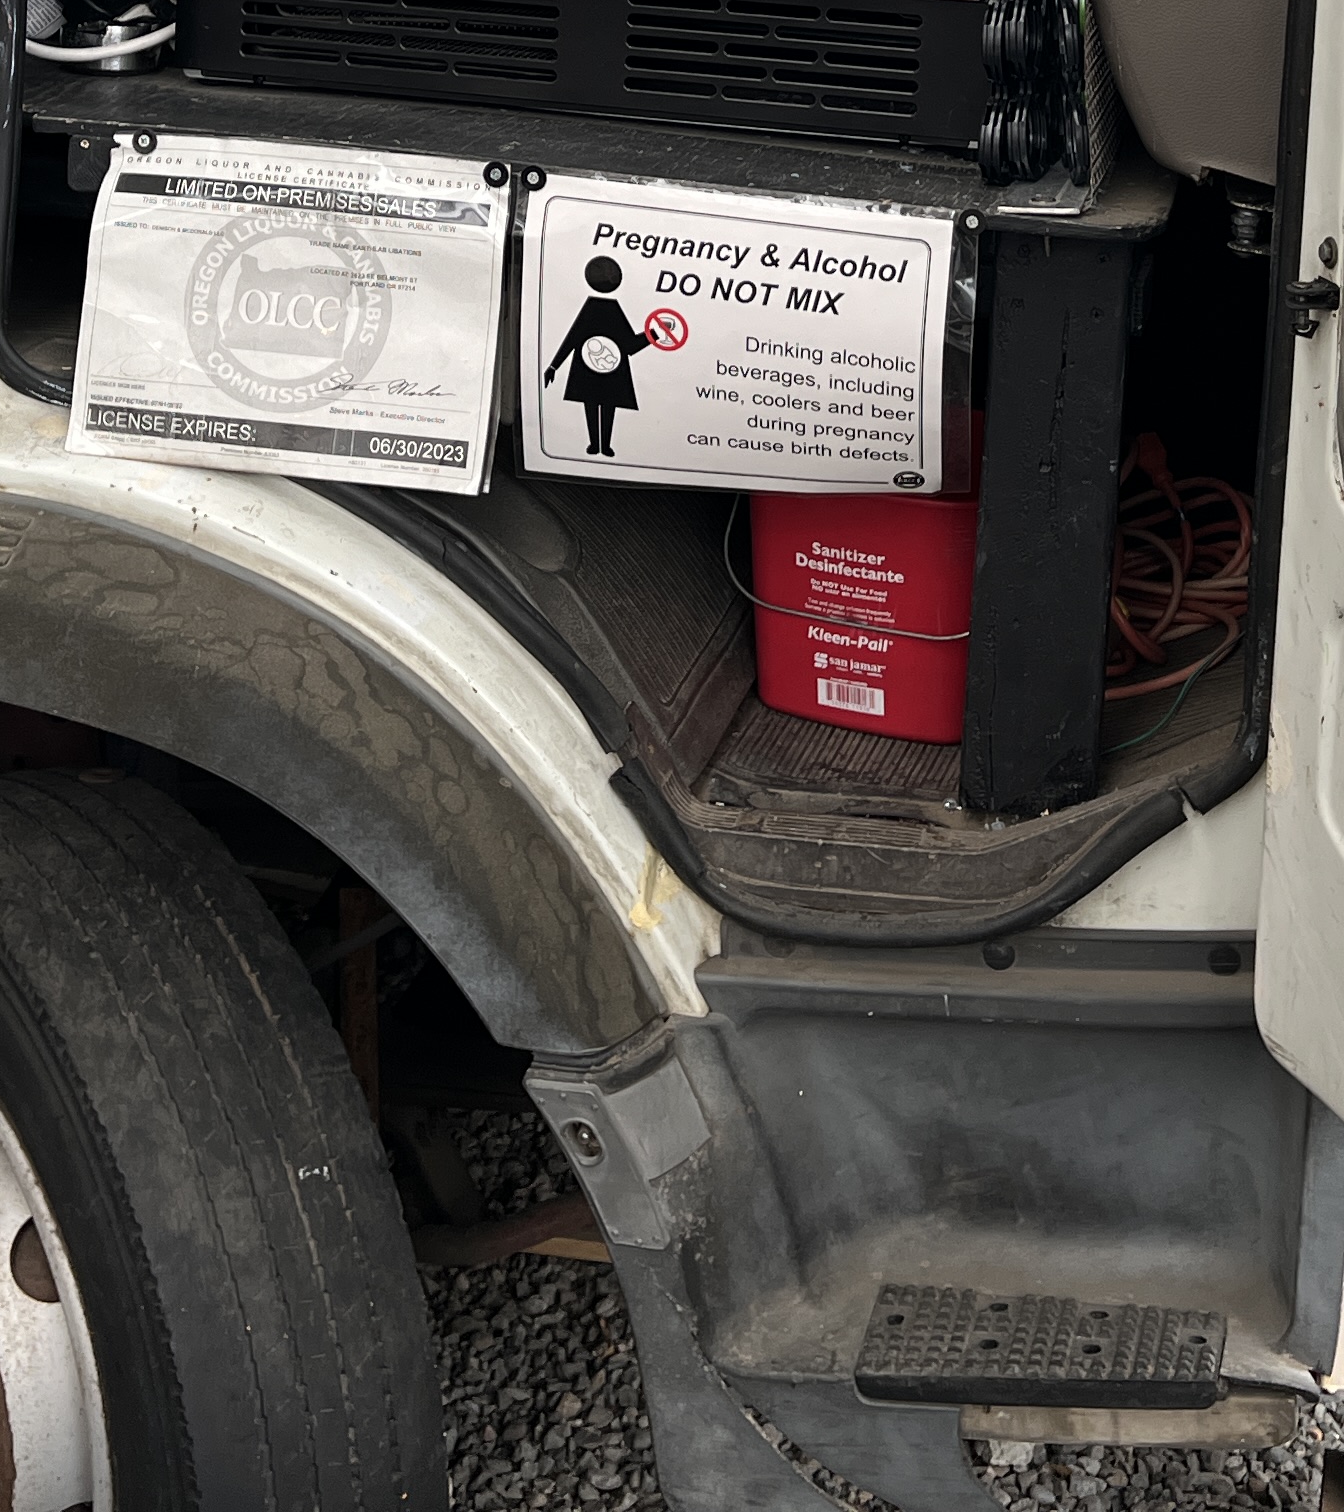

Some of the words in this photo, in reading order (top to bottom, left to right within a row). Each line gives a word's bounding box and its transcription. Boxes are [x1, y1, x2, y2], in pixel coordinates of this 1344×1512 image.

[127, 155, 183, 166] OREGON
[196, 158, 250, 170] LIQUOR
[264, 164, 292, 174] AND
[306, 167, 380, 182] CANNABIS
[237, 172, 288, 184] LICENSE
[293, 176, 370, 191] CERTIFICATE
[165, 178, 237, 199] LIMITED
[242, 184, 372, 212] ON-PREMISES
[376, 198, 437, 218] SALES
[142, 196, 158, 204] THIS
[162, 198, 206, 210] CERTIFICATE
[211, 202, 231, 212] MUST
[236, 205, 246, 213] BE
[251, 206, 294, 217] MAINTAINED
[299, 210, 310, 218] ON
[316, 212, 329, 222] THE
[334, 214, 369, 225] PREMISES
[373, 218, 380, 226] IN
[385, 219, 402, 229] FULL
[407, 221, 433, 231] PUBLIC
[438, 224, 456, 233] VIEW
[309, 240, 331, 248] TRADE
[592, 223, 751, 269] Pregnancy
[760, 244, 781, 269] &
[790, 247, 909, 284] Alcohol
[191, 236, 234, 326] OREGON
[233, 209, 319, 243] LIQUOR
[340, 236, 383, 346] CANNABIS
[310, 268, 340, 277] LOCATED
[350, 281, 385, 289] PORTLAND
[238, 288, 342, 330] OLCC
[655, 270, 702, 297] DO
[710, 277, 778, 306] NOT
[785, 287, 845, 316] MIX
[745, 336, 824, 365] Drinking
[830, 347, 917, 374] alcoholic
[207, 352, 351, 405] COMMISSION
[715, 359, 822, 389] beverages,
[828, 373, 915, 402] including
[329, 407, 350, 415] Steve
[351, 408, 374, 417] Marks
[380, 411, 415, 421] Executive
[416, 414, 446, 424] Director
[696, 386, 746, 406] wine,
[751, 390, 821, 413] coolers
[828, 399, 864, 417] and
[871, 404, 916, 423] beer
[87, 407, 165, 433] LICENSE
[170, 417, 257, 442] EXPIRES:
[746, 413, 806, 437] during
[813, 424, 915, 446] pregnancy
[369, 437, 464, 463] 06/30/2023
[686, 433, 720, 448] can
[727, 437, 784, 454] cause
[790, 441, 832, 459] birth
[838, 444, 916, 463] defects.
[795, 552, 905, 584] Desinfectante
[811, 542, 886, 566] Sanitizer
[810, 578, 820, 586] Do
[822, 581, 838, 589] NOT
[840, 584, 854, 592] Use
[855, 586, 868, 594] For
[869, 589, 888, 597] Food
[808, 625, 889, 652] Kleen-Pail
[829, 656, 848, 667] san
[850, 658, 884, 673] jamar
